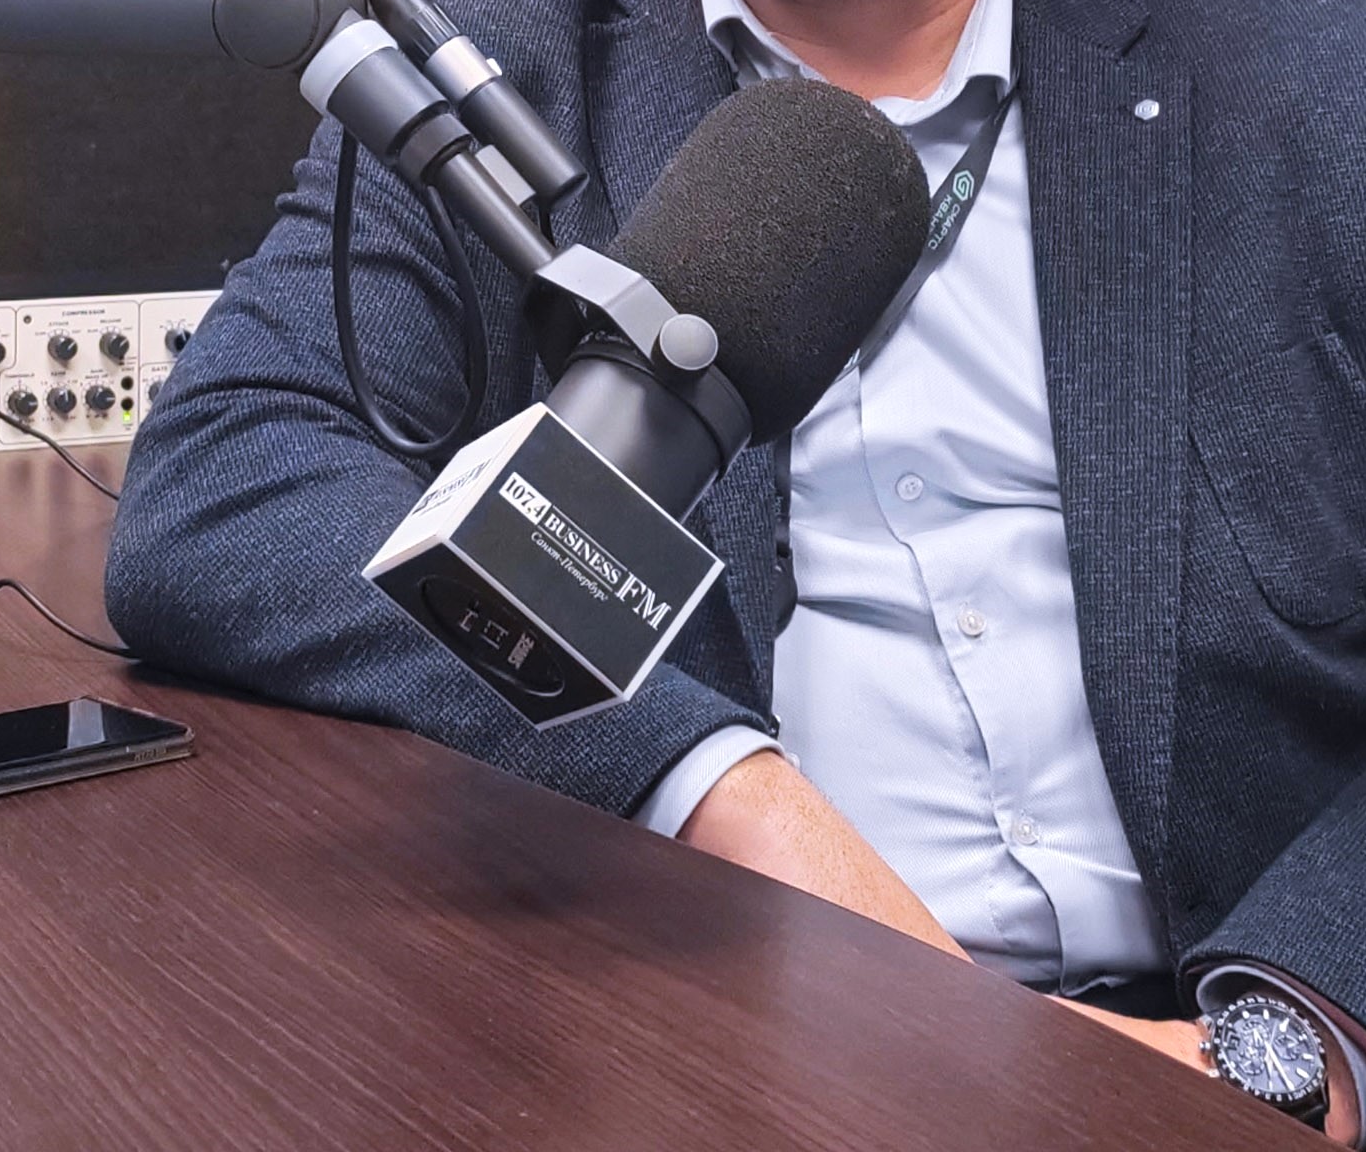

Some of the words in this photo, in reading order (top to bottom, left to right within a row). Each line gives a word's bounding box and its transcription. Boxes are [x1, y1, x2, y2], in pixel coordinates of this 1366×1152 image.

[502, 475, 547, 522] 107,4
[543, 512, 623, 586] BUSINESS
[614, 571, 672, 632] FM
[530, 532, 610, 604] Санкт-Петербург
